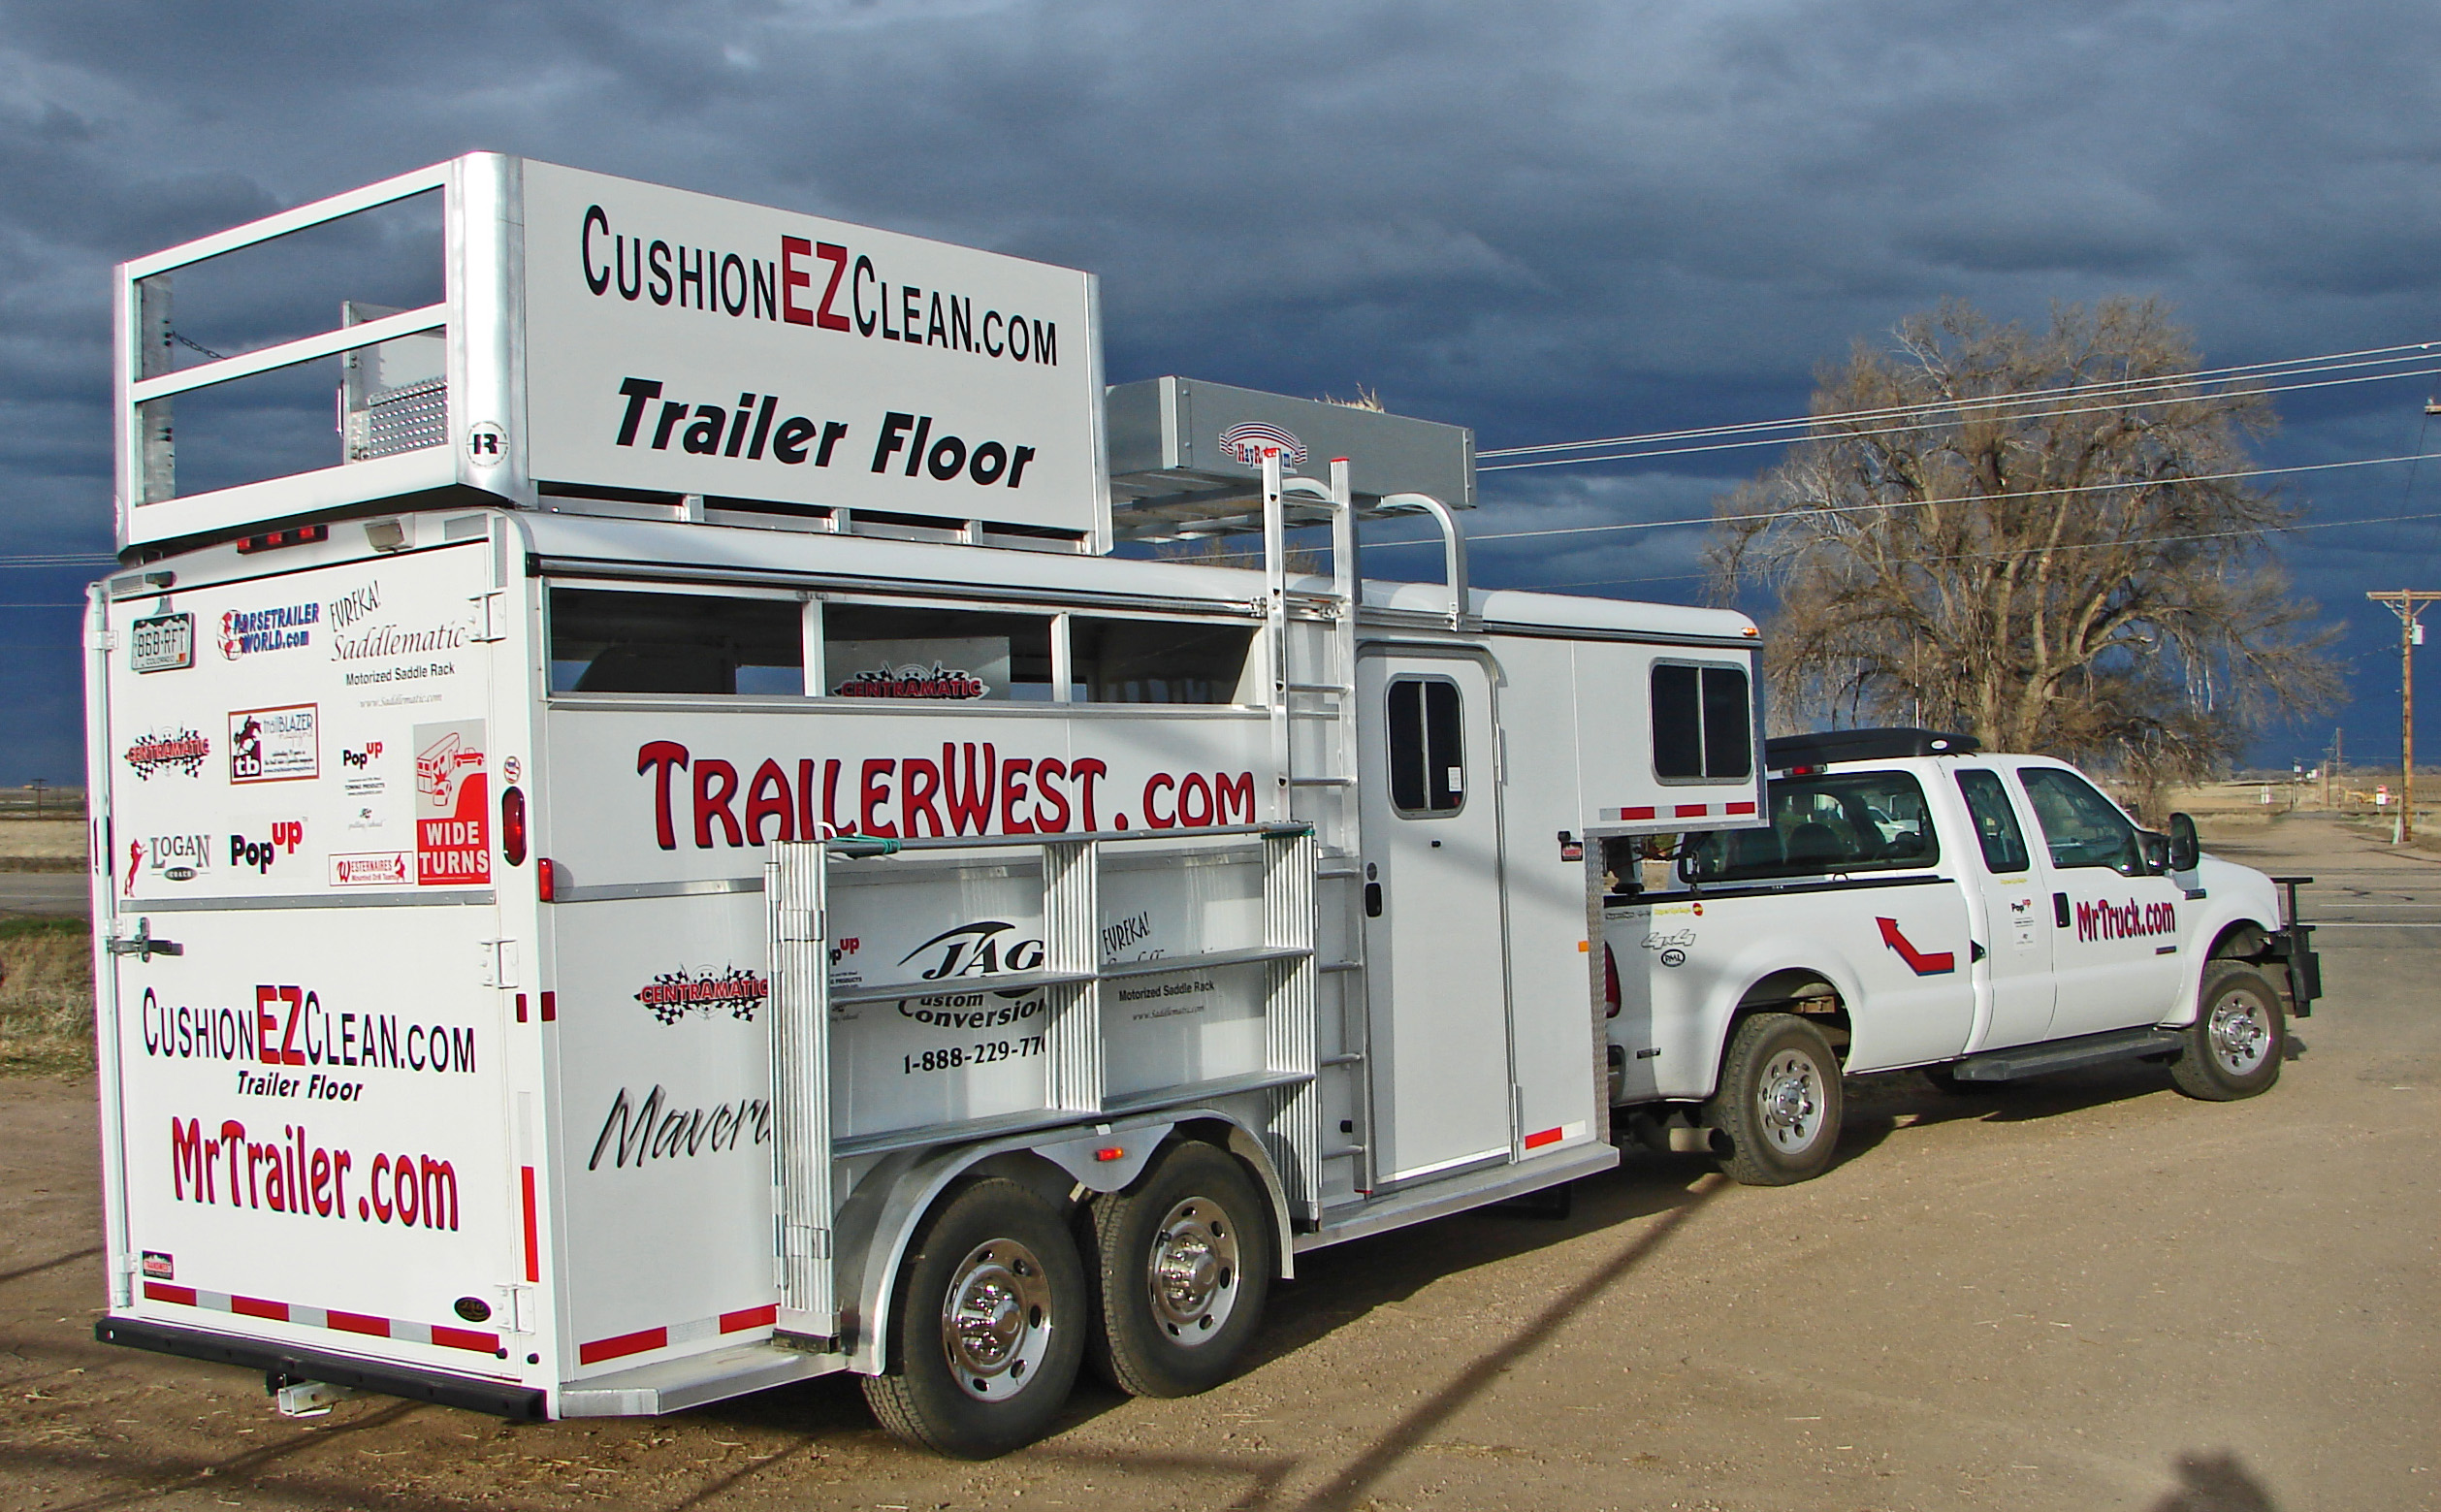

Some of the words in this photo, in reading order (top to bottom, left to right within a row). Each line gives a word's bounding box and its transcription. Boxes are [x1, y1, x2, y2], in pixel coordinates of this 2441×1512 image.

[616, 376, 849, 469] Trailer
[871, 411, 1036, 490] Floor
[330, 621, 466, 661] Saddlematic
[345, 668, 392, 687] Motorized
[395, 664, 428, 681] Saddle
[430, 661, 456, 677] Rack
[841, 679, 982, 697] CENTRAMATIC
[128, 738, 210, 762] CENTRAMATIC
[235, 755, 262, 776] tb
[426, 820, 480, 847] WIDE
[150, 834, 211, 869] LOGAN
[419, 849, 489, 875] TURNS
[1102, 911, 1151, 956] EUREKA!
[2076, 896, 2176, 943] MrTruck.com
[921, 938, 1045, 981] JAG
[1118, 985, 1162, 1002] Motorized
[1163, 982, 1193, 998] Saddle
[1194, 980, 1215, 993] Rack
[903, 1035, 1045, 1076] 1-888-229-77
[238, 1070, 301, 1099] Trailer
[307, 1074, 364, 1103] Floor
[172, 1115, 460, 1232] MrTrailer.com
